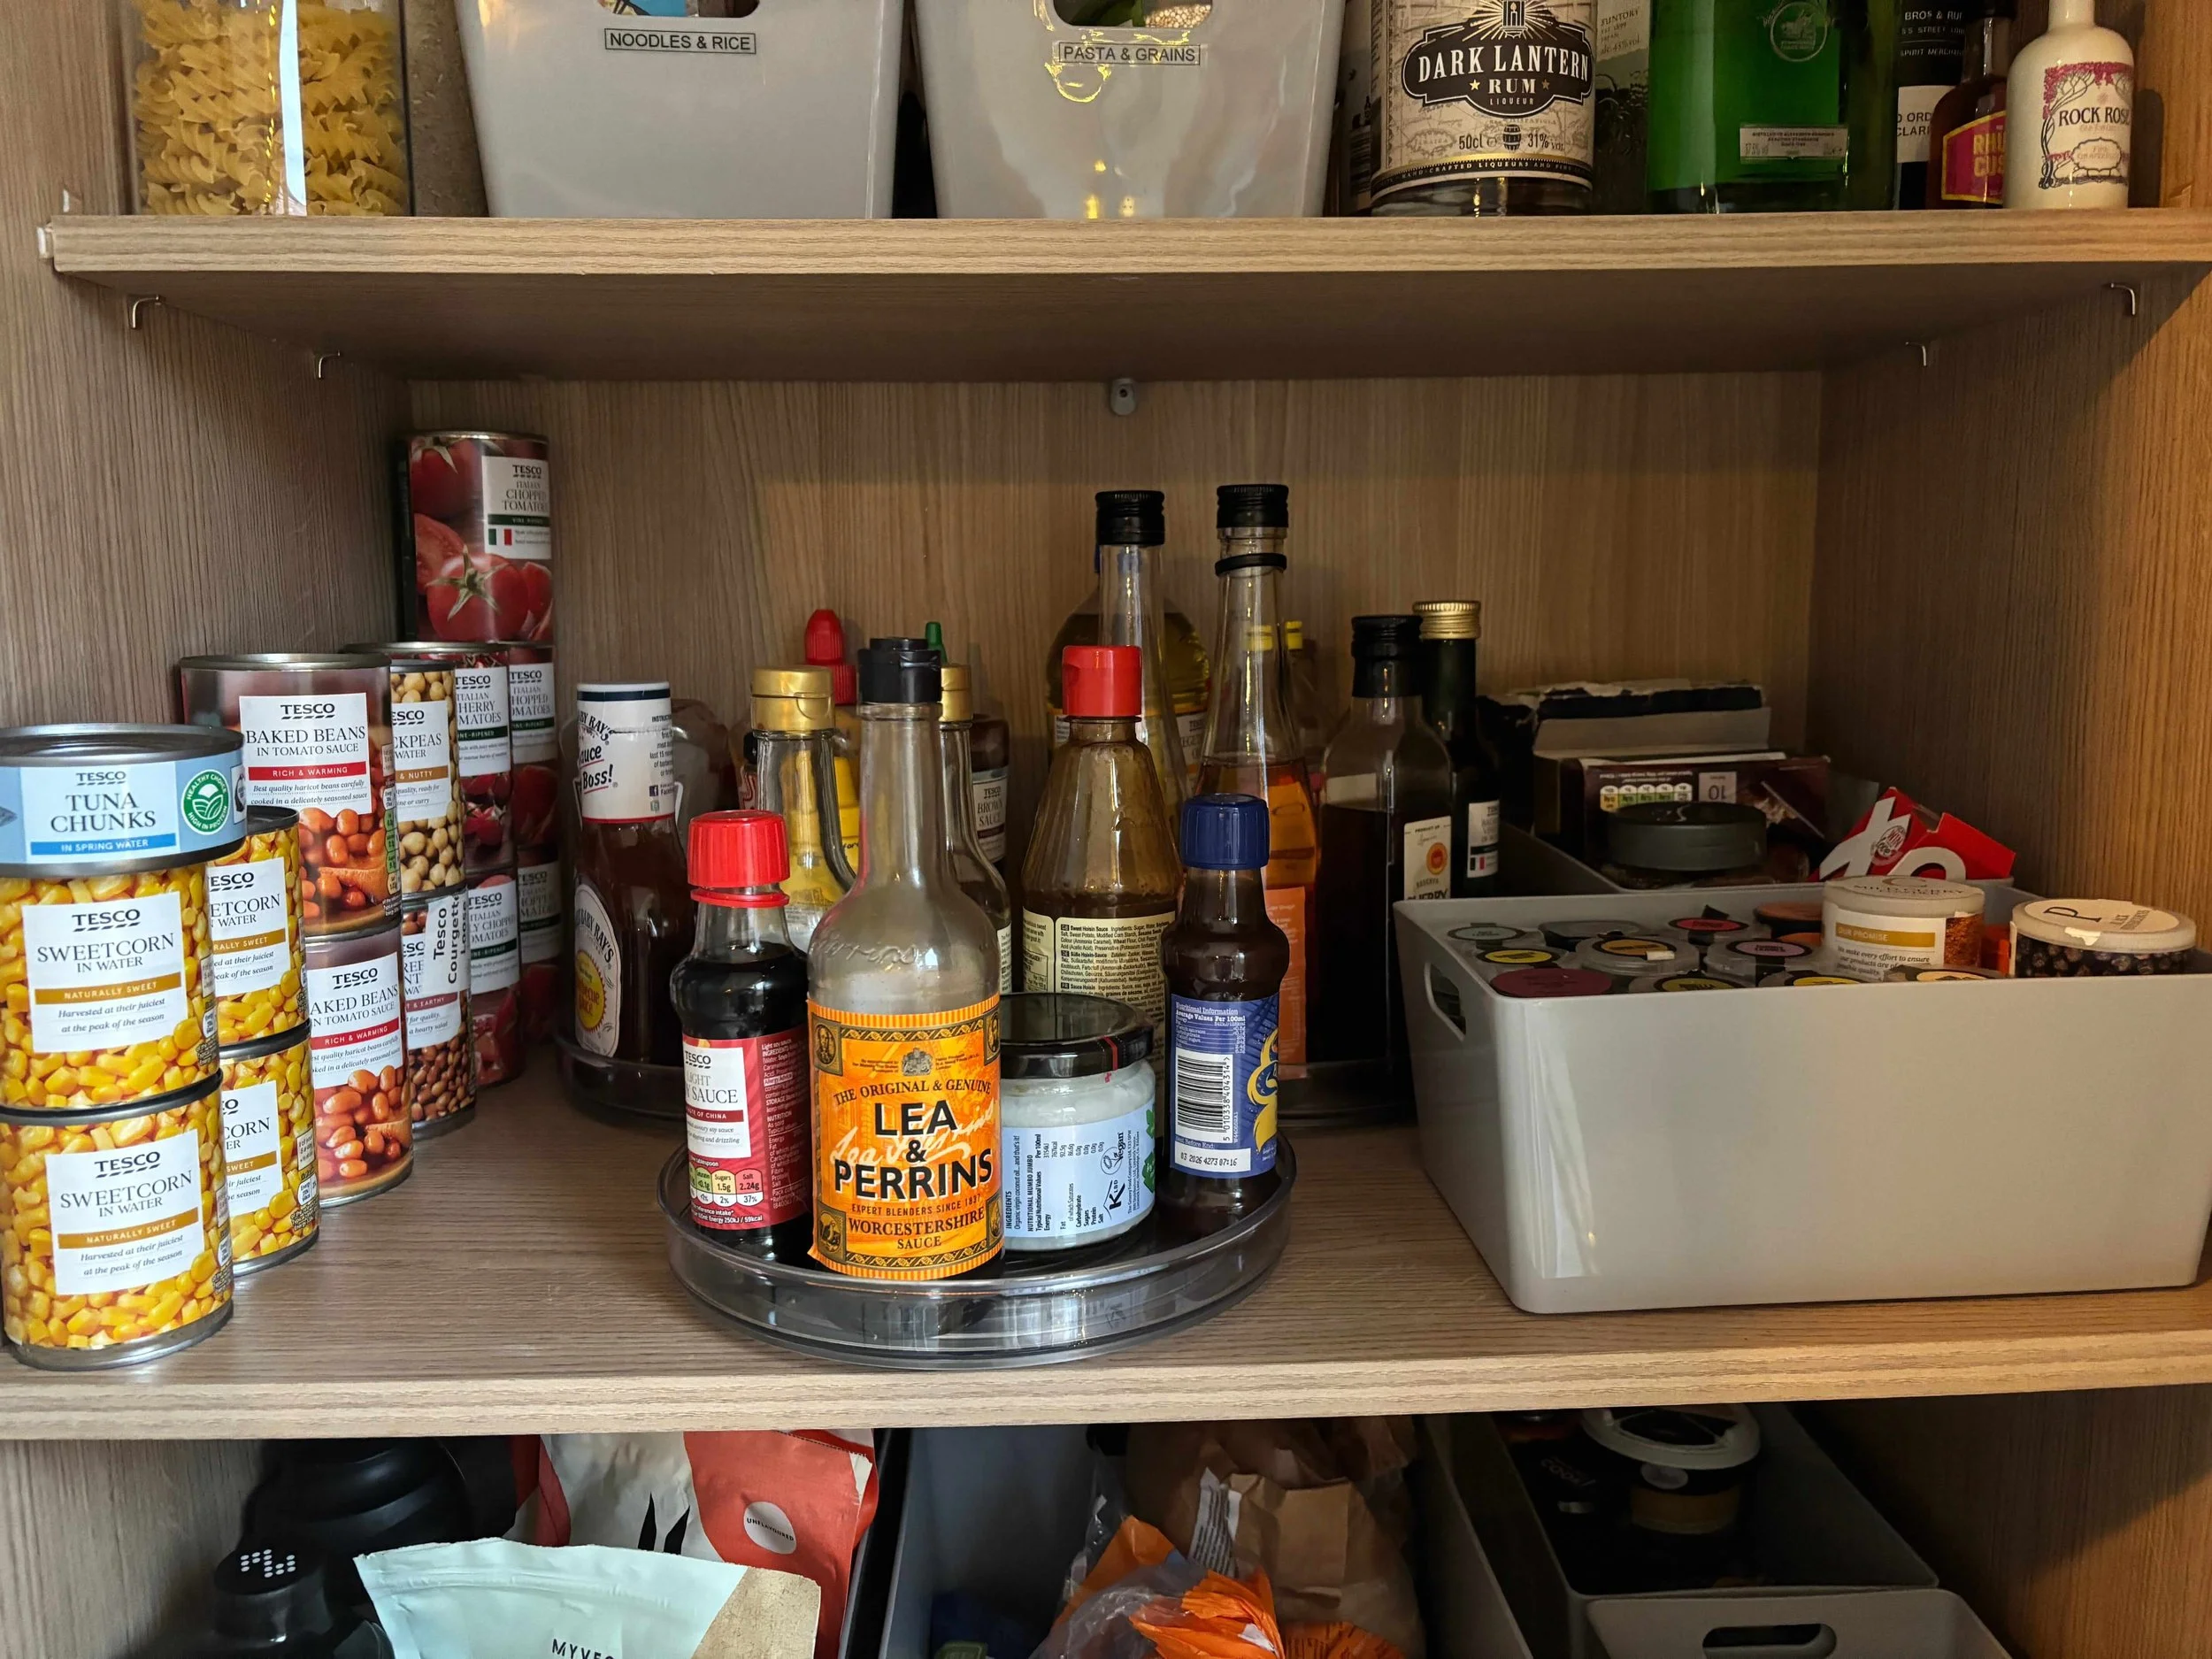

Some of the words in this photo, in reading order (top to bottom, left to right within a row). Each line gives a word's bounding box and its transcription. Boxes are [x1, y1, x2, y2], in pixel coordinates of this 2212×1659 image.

[611, 33, 691, 49] NOODLES
[697, 36, 707, 49] &
[713, 37, 750, 50] RICE
[1064, 47, 1115, 60] PASTA
[1120, 48, 1130, 60] &
[1136, 49, 1194, 61] GRAINS
[1418, 47, 1485, 83] DARK
[1494, 45, 1589, 81] LANTERN
[1488, 79, 1536, 94] RUM
[2059, 107, 2101, 127] ROCK
[1459, 134, 1483, 150] 50cl
[1527, 134, 1548, 149] 31%
[512, 465, 541, 474] TESCO
[510, 671, 541, 680] TESCO
[280, 703, 335, 715] TESCO
[246, 730, 308, 744] BAKED
[314, 726, 365, 742] BEANS
[257, 747, 269, 757] IN
[273, 746, 324, 756] TOMATO
[326, 743, 359, 754] SAUCE
[76, 771, 127, 781] TESCO
[187, 774, 210, 800] HEALTHY
[211, 774, 227, 794] CHOICE
[65, 793, 140, 812] TUNA
[50, 810, 157, 833] CHUNKS
[72, 909, 141, 926] TESCO
[218, 914, 257, 927] WATER
[434, 908, 447, 960] Tesco
[1853, 929, 1889, 941] PROMISE
[37, 933, 175, 963] SWEETCORN
[594, 925, 614, 964] RAY'S
[234, 955, 251, 964] their
[253, 951, 274, 963] juiciest
[1846, 949, 1859, 957] make
[1861, 951, 1878, 960] every
[1878, 953, 1897, 962] effort
[77, 963, 92, 973] IN
[96, 956, 143, 972] WATER
[333, 968, 378, 985] TESCO
[64, 984, 122, 1000] NATURALLY
[126, 981, 157, 994] SWEET
[361, 984, 398, 1007] BEANS
[58, 1004, 103, 1018] Harvested
[105, 1005, 114, 1014] at
[117, 1002, 136, 1011] their
[138, 997, 165, 1010] juiciest
[325, 1010, 369, 1025] TOMATO
[372, 1002, 395, 1016] SAUCE
[1176, 1002, 1202, 1015] Nutritional
[1202, 1006, 1238, 1015] Information
[1176, 1010, 1194, 1019] Average
[325, 1035, 345, 1045] RICH
[356, 1026, 388, 1041] WARMING
[685, 1051, 711, 1064] TESCO
[692, 1087, 738, 1103] SAUCE
[833, 1089, 857, 1106] THE
[860, 1080, 929, 1098] ORIGINAL
[933, 1081, 942, 1091] &
[946, 1079, 992, 1095] GENUINE
[875, 1100, 957, 1136] LEA
[905, 1140, 926, 1163] &
[94, 1151, 161, 1172] TESCO
[237, 1175, 262, 1187] juiciest
[834, 1148, 993, 1199] PERRINS
[60, 1170, 193, 1209] SWEETCORN
[236, 1189, 260, 1200] season
[718, 1184, 731, 1193] 1.5g
[740, 1182, 760, 1191] 2.24g
[99, 1207, 114, 1217] IN
[118, 1196, 163, 1214] WATER
[849, 1206, 985, 1236] WORCESTERSHIRE
[87, 1229, 142, 1244] NATURALLY
[147, 1219, 176, 1234] SWEET
[81, 1249, 124, 1262] Harvested
[137, 1243, 155, 1253] their
[157, 1234, 183, 1250] juiciest
